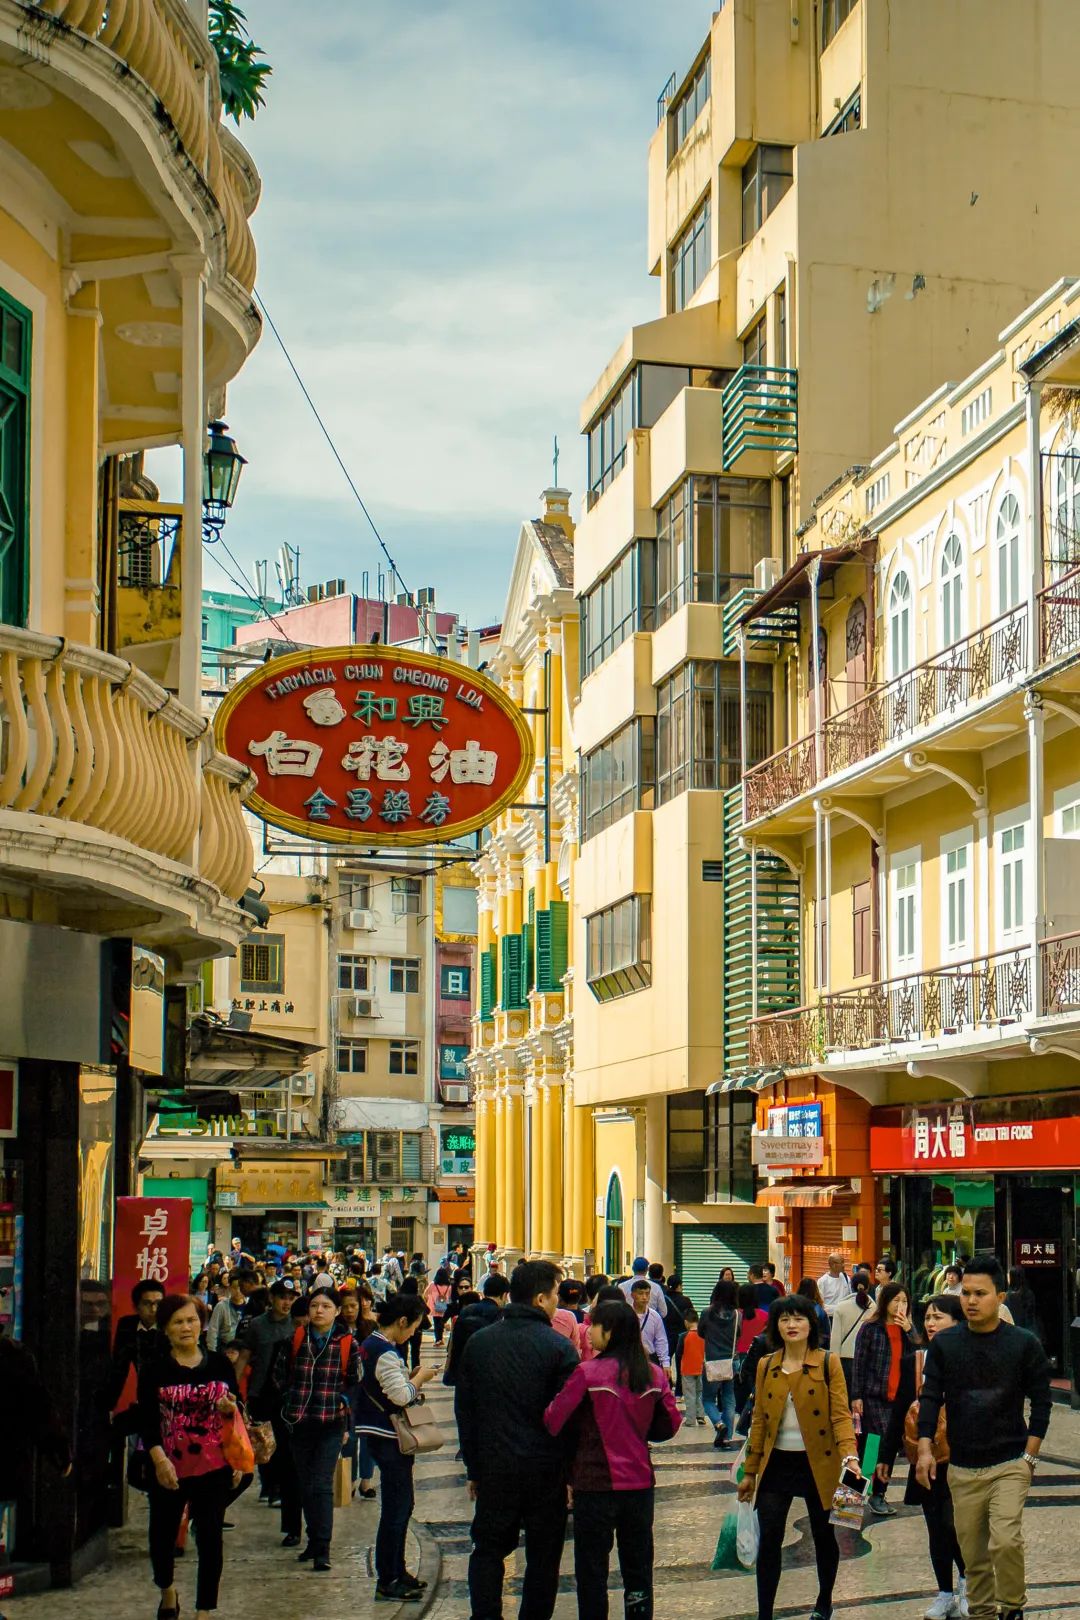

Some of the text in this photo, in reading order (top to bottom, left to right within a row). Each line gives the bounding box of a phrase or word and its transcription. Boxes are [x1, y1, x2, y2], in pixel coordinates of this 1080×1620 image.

[344, 664, 384, 681] CHUN
[393, 666, 449, 692] CHEONG
[352, 690, 449, 731] 和興
[248, 730, 498, 785] 白花油
[761, 1140, 812, 1151] Sweetmay
[914, 1115, 965, 1158] 周大福
[975, 1125, 1033, 1142] CHOW TAI FOOK
[1021, 1243, 1056, 1255] 周大福
